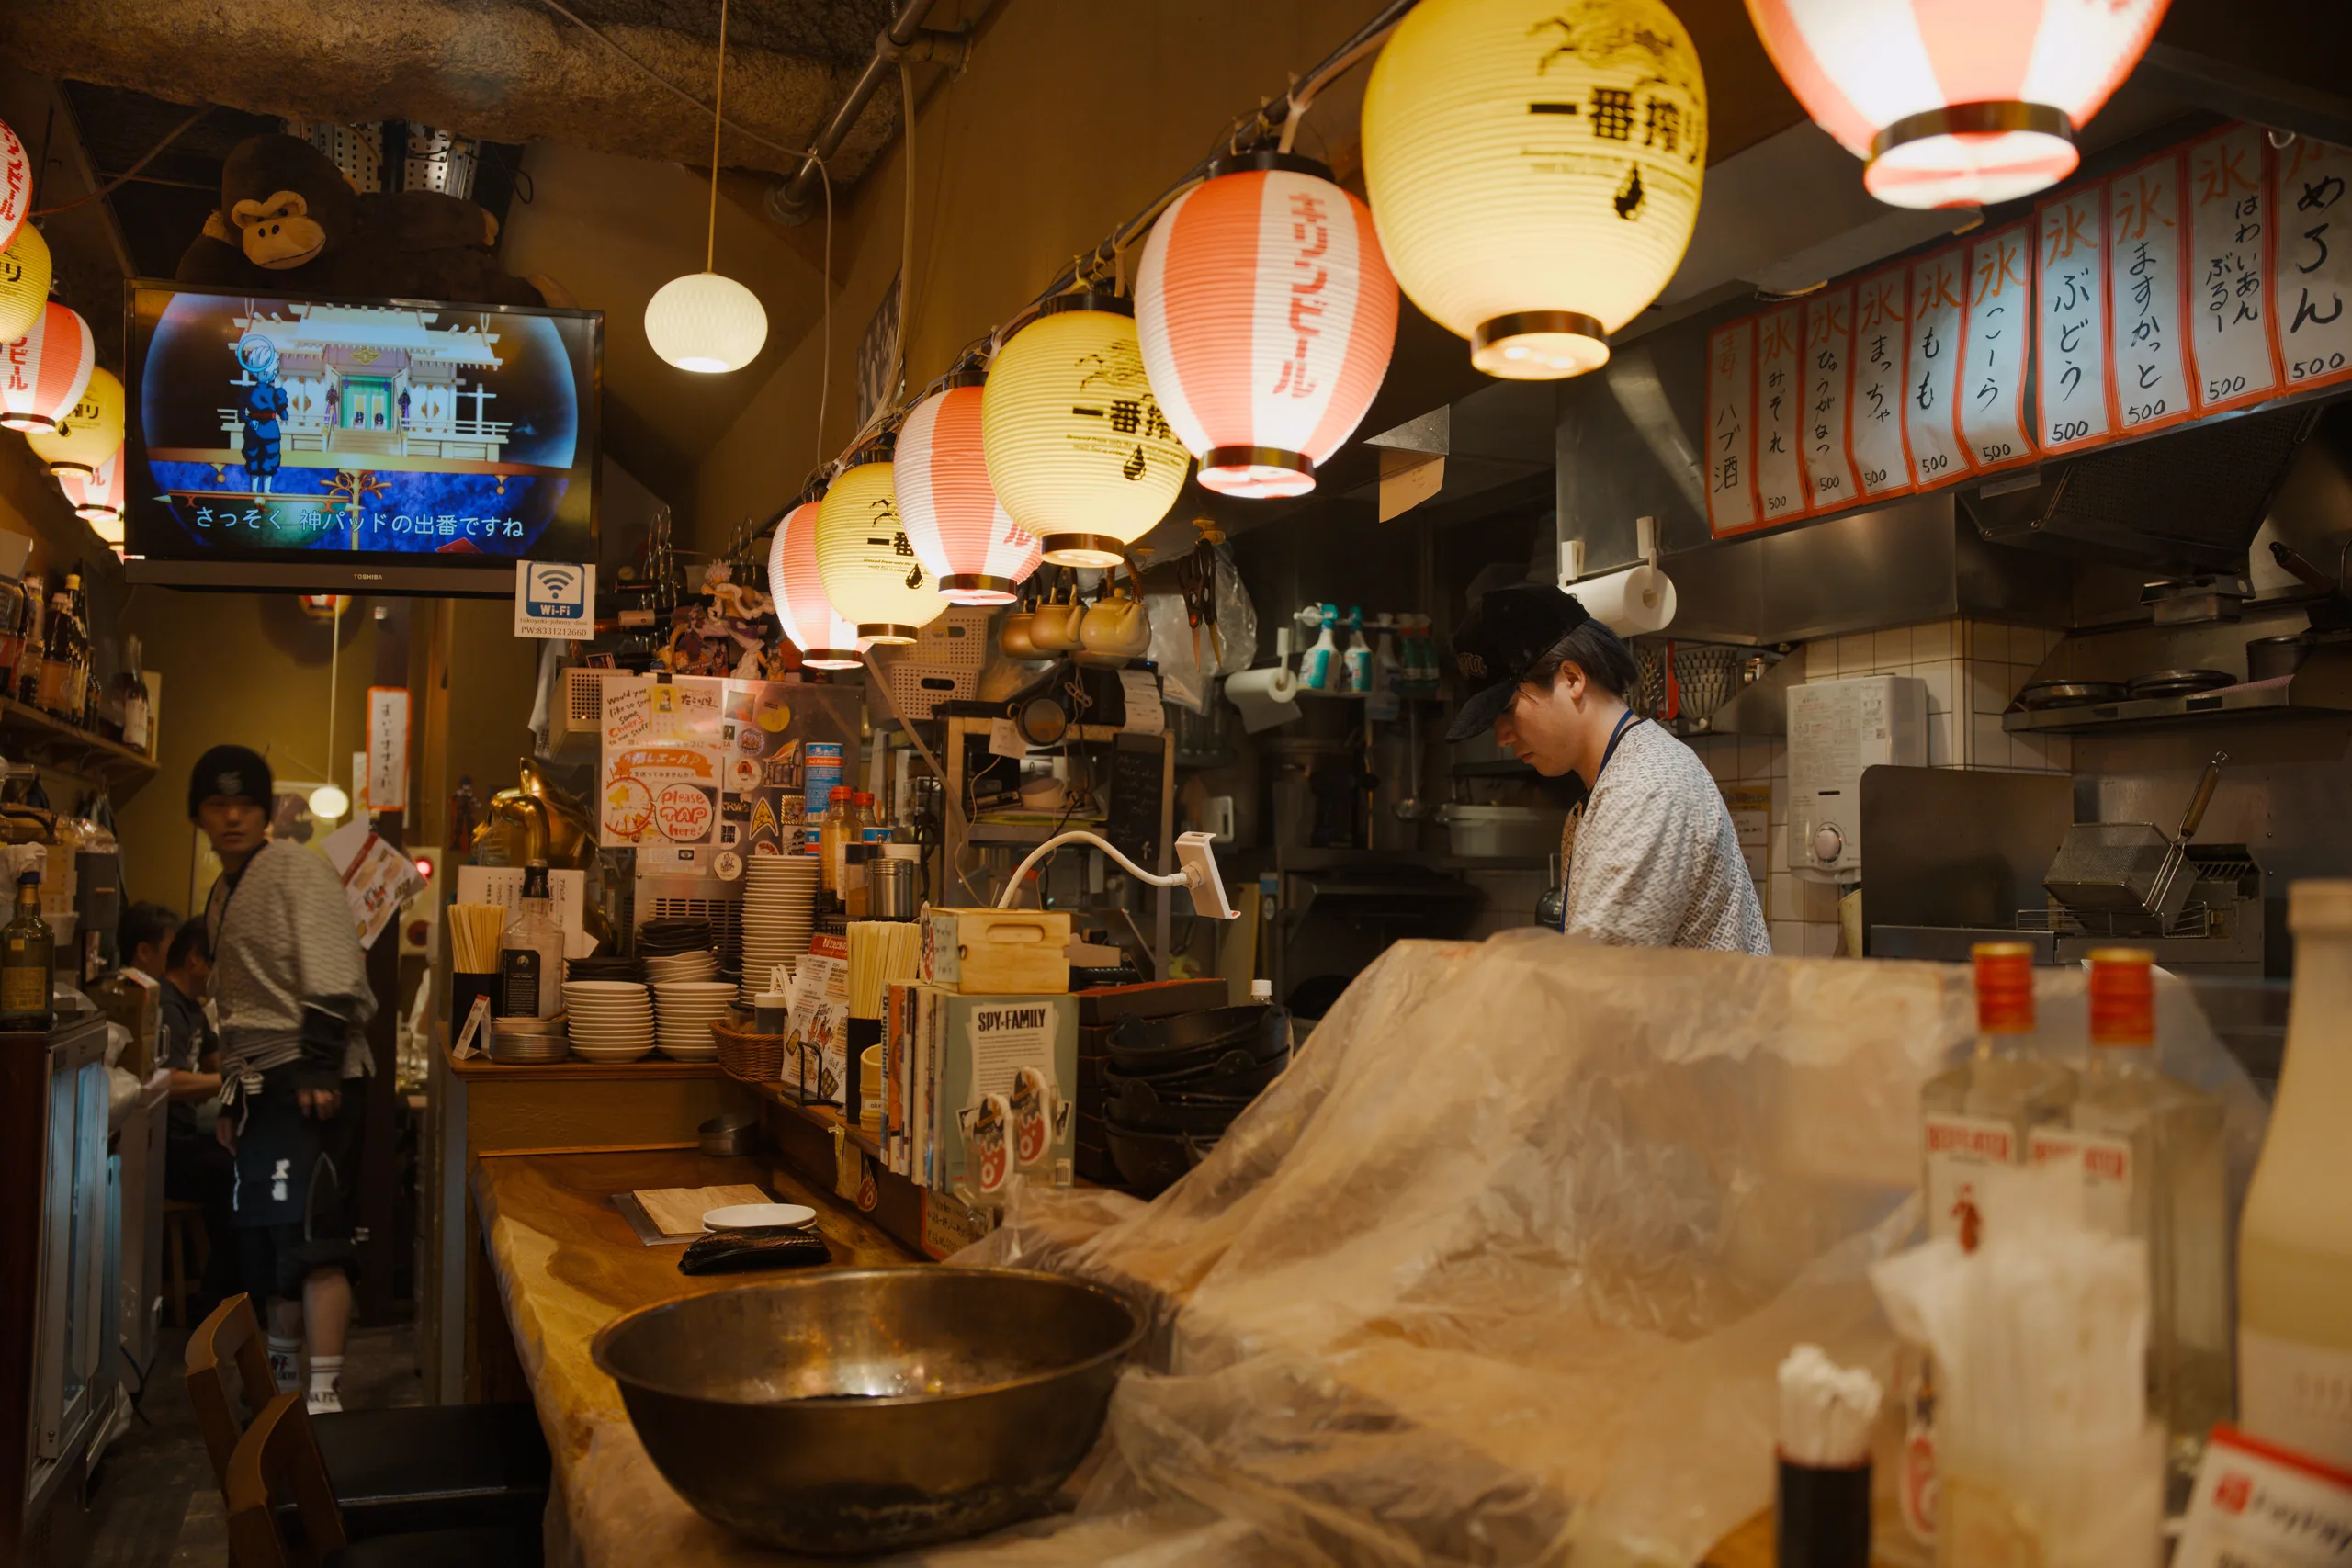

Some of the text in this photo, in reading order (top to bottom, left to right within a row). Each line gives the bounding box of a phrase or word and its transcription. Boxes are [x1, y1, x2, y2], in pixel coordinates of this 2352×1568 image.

[2198, 143, 2261, 326] 氷 はわいあん
[2290, 175, 2346, 334] めろん
[2115, 175, 2177, 389] 氷 ますかっと
[2206, 252, 2233, 333] ぶるー
[1273, 192, 1329, 399] キリンビール
[1860, 282, 1903, 335] 氷
[2045, 204, 2099, 402] 氷 ぶどう
[1916, 265, 1961, 410] 氷 もも
[1973, 242, 2026, 413] 氷 こーら
[1809, 302, 1848, 456] 氷 ひゅうがなつ
[2291, 353, 2346, 379] 500
[1763, 317, 1795, 454] 氷 みぞれ
[2208, 375, 2245, 400] 500
[2128, 400, 2165, 424] 500
[2052, 420, 2089, 442] 500
[1714, 403, 1741, 493] ハブ酒
[1983, 444, 2011, 462] 500
[1922, 455, 1948, 473] 500
[1819, 475, 1840, 491] 500
[1865, 468, 1888, 487] 500
[1769, 495, 1787, 510] 500
[196, 507, 525, 537] さっそく 神パッドの出番ですね
[539, 604, 571, 616] Wi-Fi
[521, 627, 587, 637] PW:8331212660
[633, 688, 647, 699] you
[659, 806, 708, 824] TAP
[669, 824, 704, 837] here!
